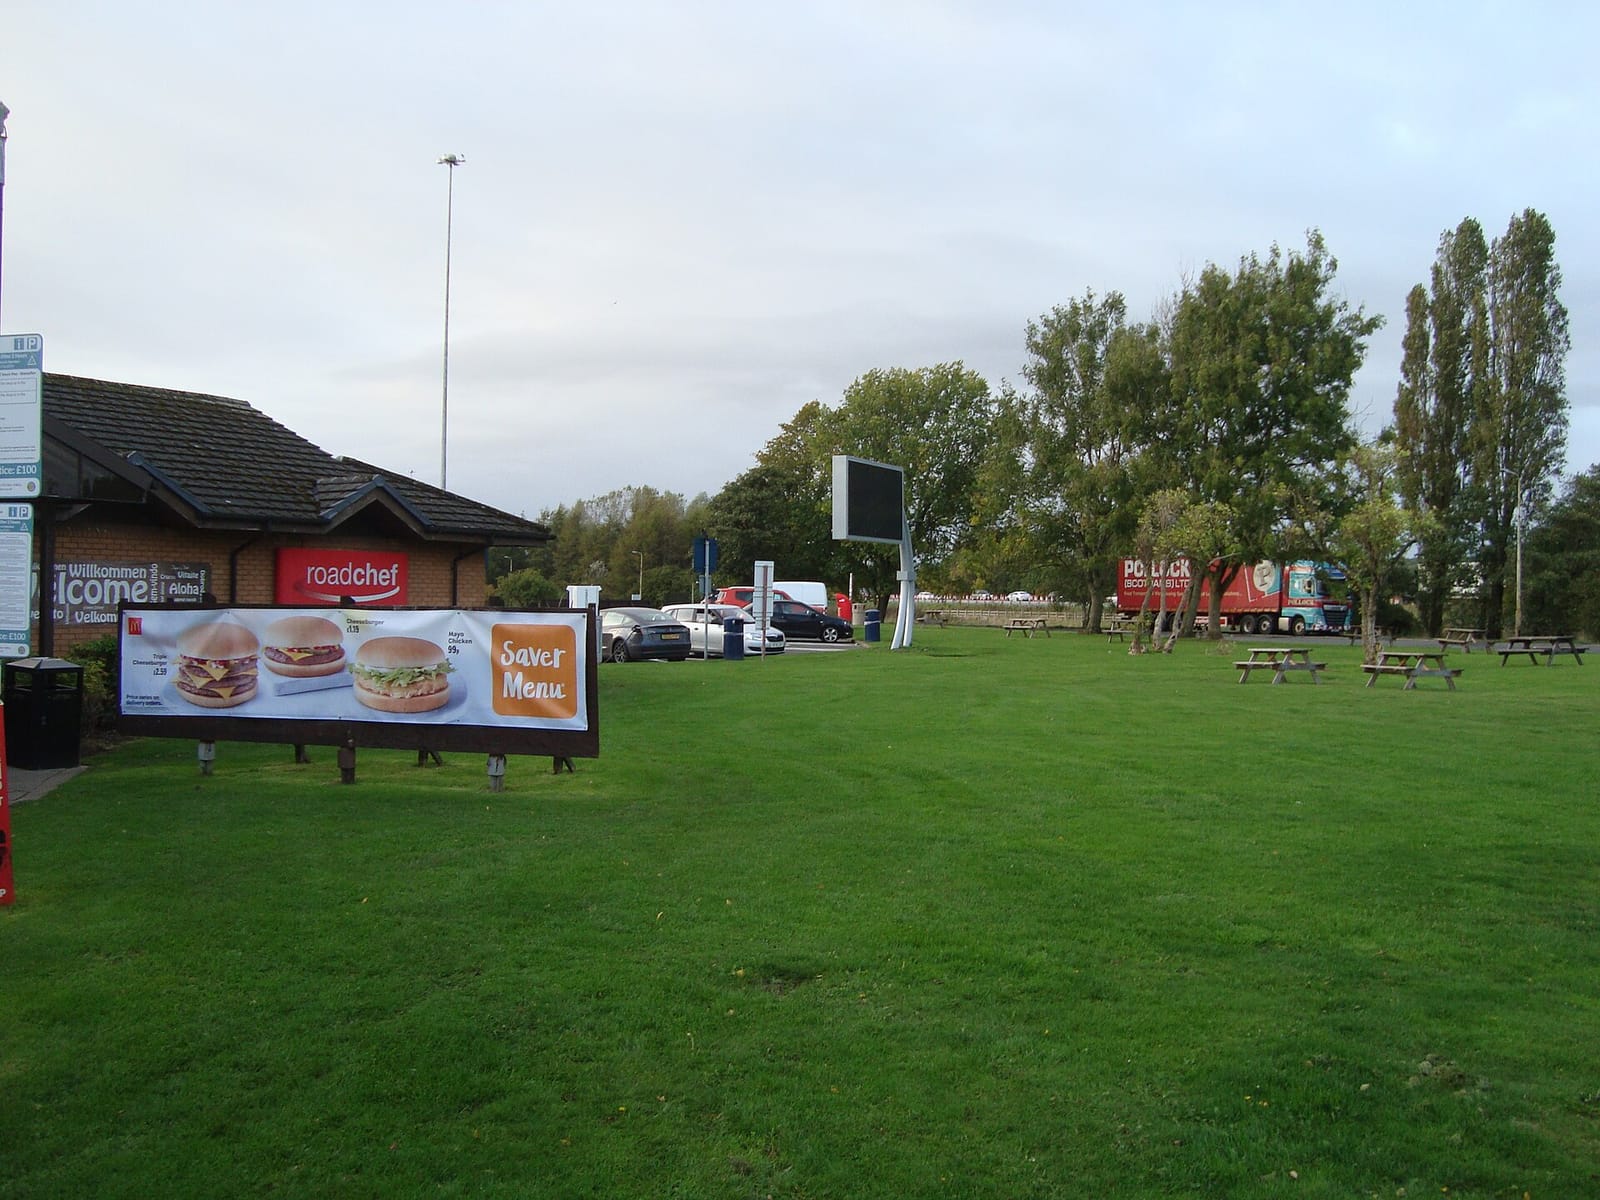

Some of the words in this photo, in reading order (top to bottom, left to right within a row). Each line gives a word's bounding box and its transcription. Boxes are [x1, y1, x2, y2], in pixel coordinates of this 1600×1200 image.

[16, 465, 37, 475] £100
[68, 563, 147, 579] Willkommen
[307, 562, 398, 586] roadchef
[1124, 559, 1190, 578] POLCK
[53, 571, 148, 605] lcome
[169, 582, 199, 595] Aloha
[74, 610, 118, 624] Velkom
[9, 632, 26, 641] £100
[448, 631, 465, 639] Mayo
[447, 645, 460, 655] 99p
[500, 640, 567, 669] Saver
[502, 671, 567, 700] Menu
